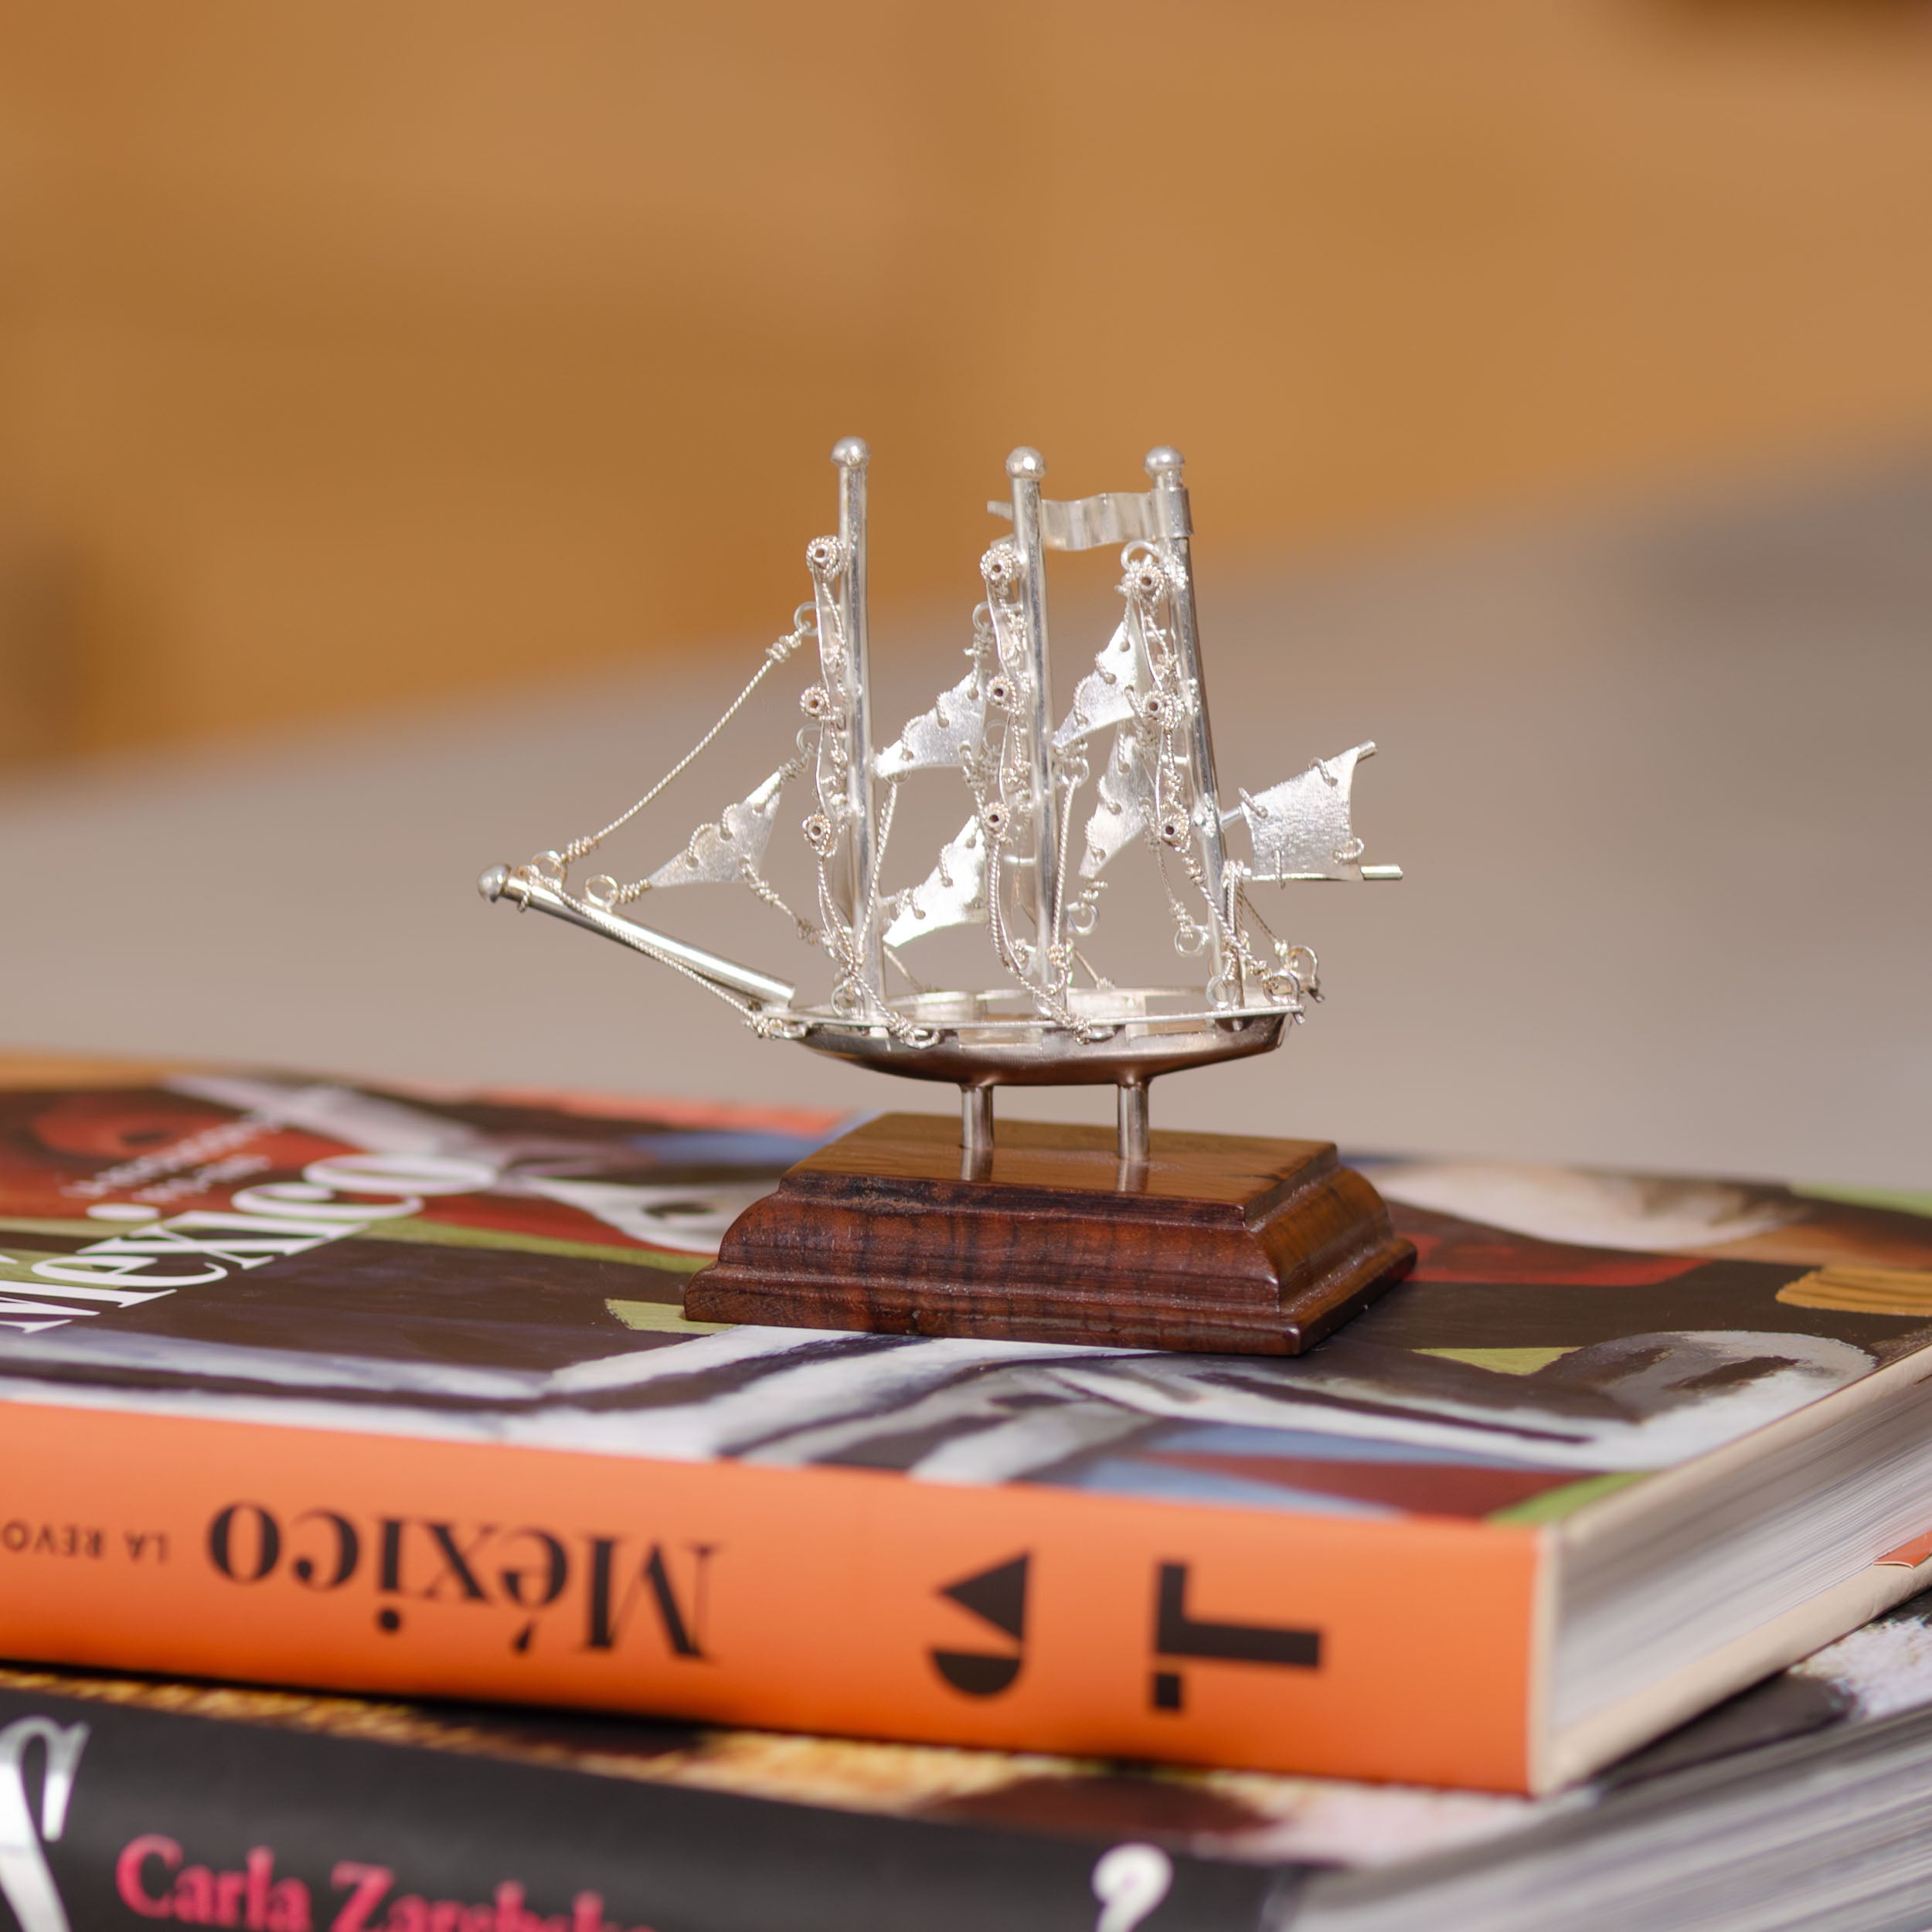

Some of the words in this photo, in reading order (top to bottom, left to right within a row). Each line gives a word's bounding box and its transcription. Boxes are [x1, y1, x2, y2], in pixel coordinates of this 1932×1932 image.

[124, 1530, 169, 1566] LA
[206, 1501, 722, 1660] México
[115, 1833, 311, 1932] Carla
[330, 1859, 657, 1932] Zareb
